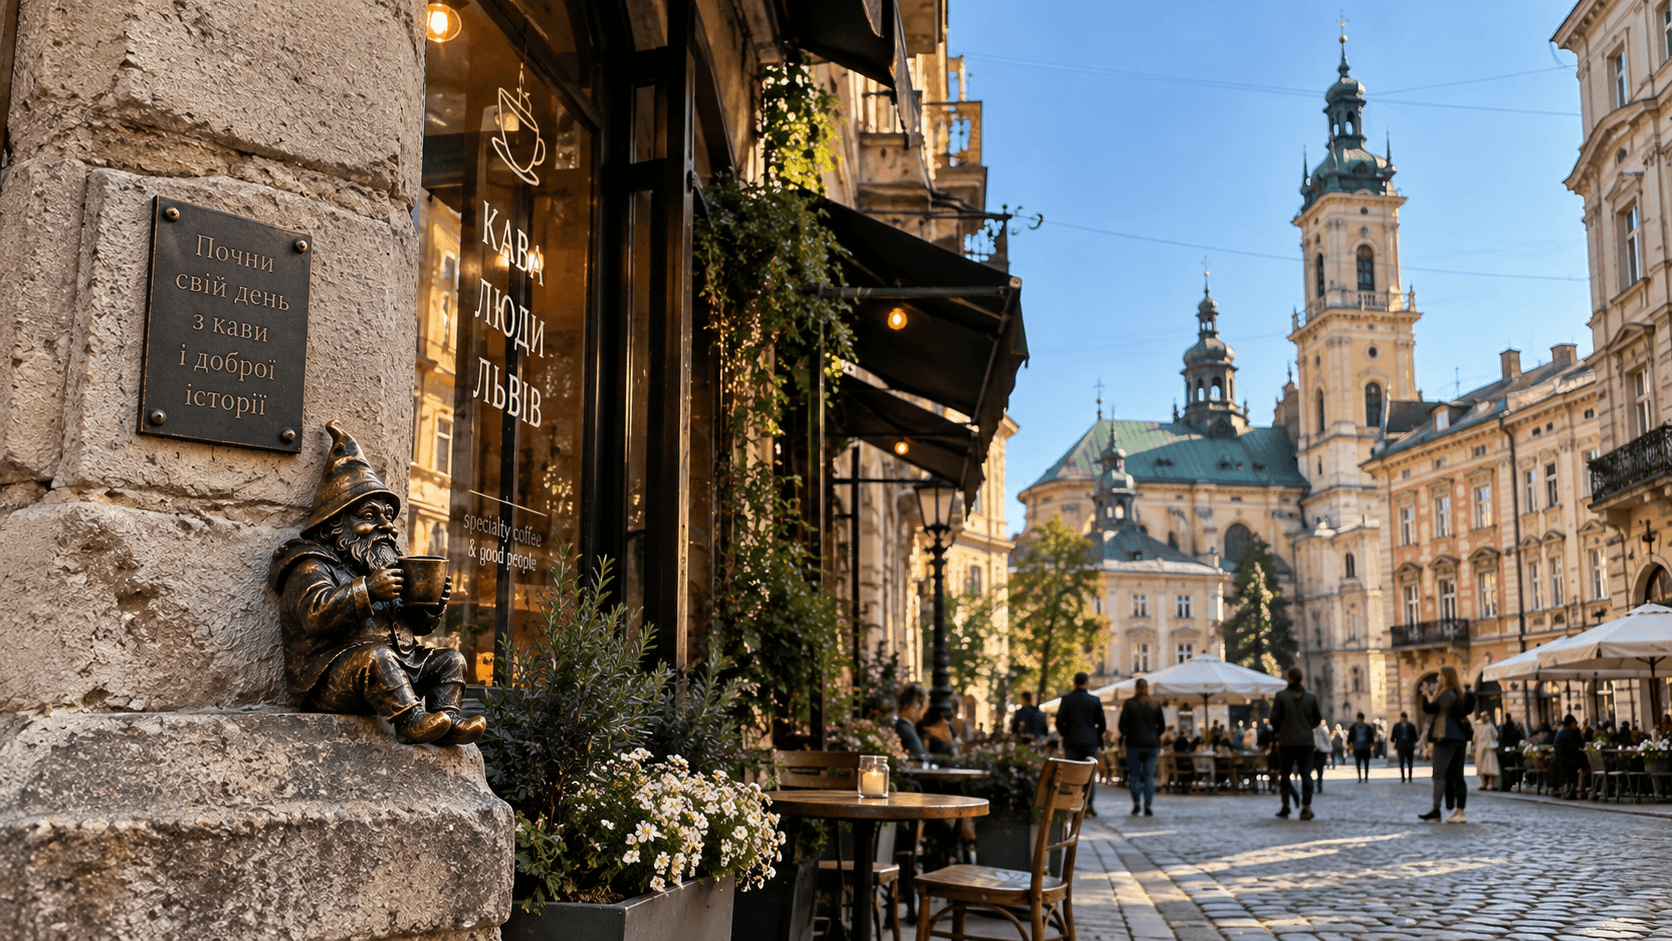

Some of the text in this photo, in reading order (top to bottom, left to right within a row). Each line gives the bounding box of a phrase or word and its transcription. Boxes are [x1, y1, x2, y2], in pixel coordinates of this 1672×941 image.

[195, 234, 274, 273] Почни
[482, 200, 544, 287] КАВА
[175, 272, 290, 311] свій день
[192, 314, 268, 342] з кави
[474, 277, 545, 359] ЛЮДИ
[179, 343, 276, 382] і доброї
[185, 382, 268, 419] історії
[472, 356, 542, 429] ЛЬВІВ
[463, 513, 542, 548] specialty coffee
[468, 538, 537, 574] & good people
